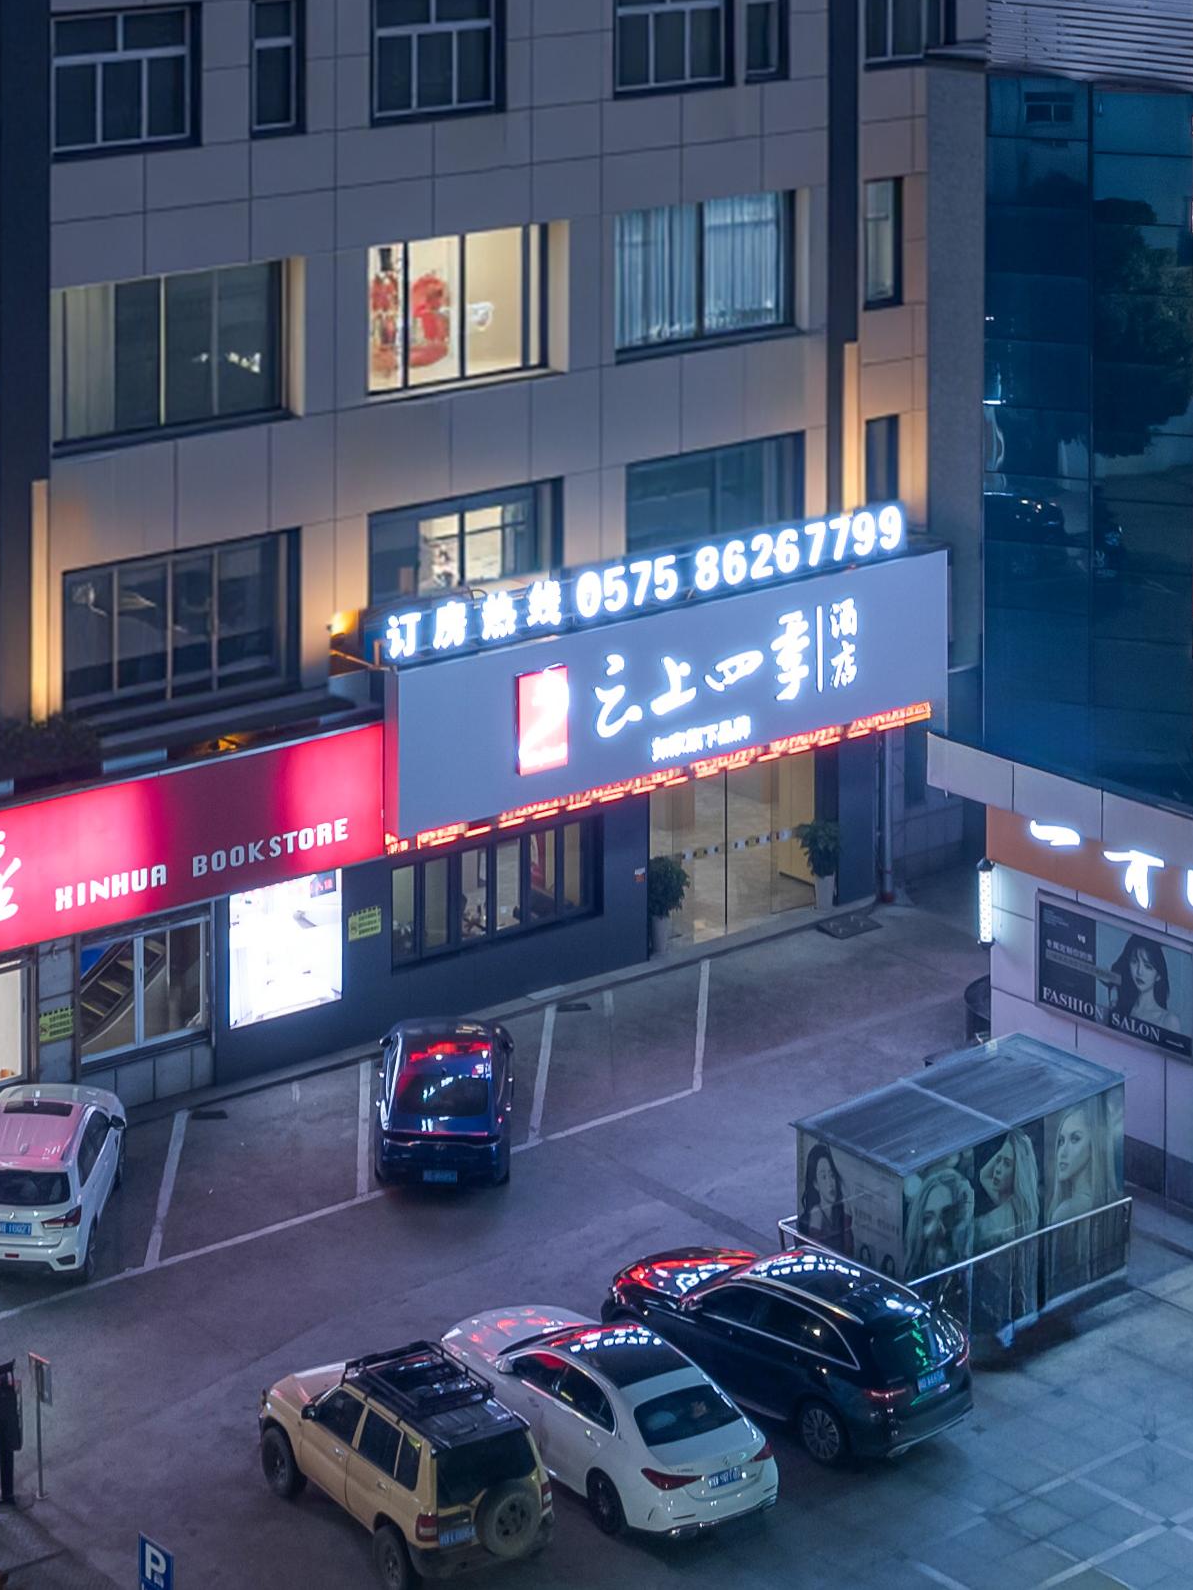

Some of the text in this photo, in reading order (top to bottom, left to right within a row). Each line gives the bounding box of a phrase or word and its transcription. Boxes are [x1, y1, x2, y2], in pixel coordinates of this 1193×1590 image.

[386, 506, 904, 659] 订房热线 0575 86267799
[594, 610, 811, 738] 云上四季
[829, 598, 858, 689] 酒店
[55, 864, 168, 912] XINHUA
[192, 817, 349, 878] BOOKSTORE
[1043, 986, 1161, 1042] FASHION SALON
[145, 1542, 167, 1581] P
